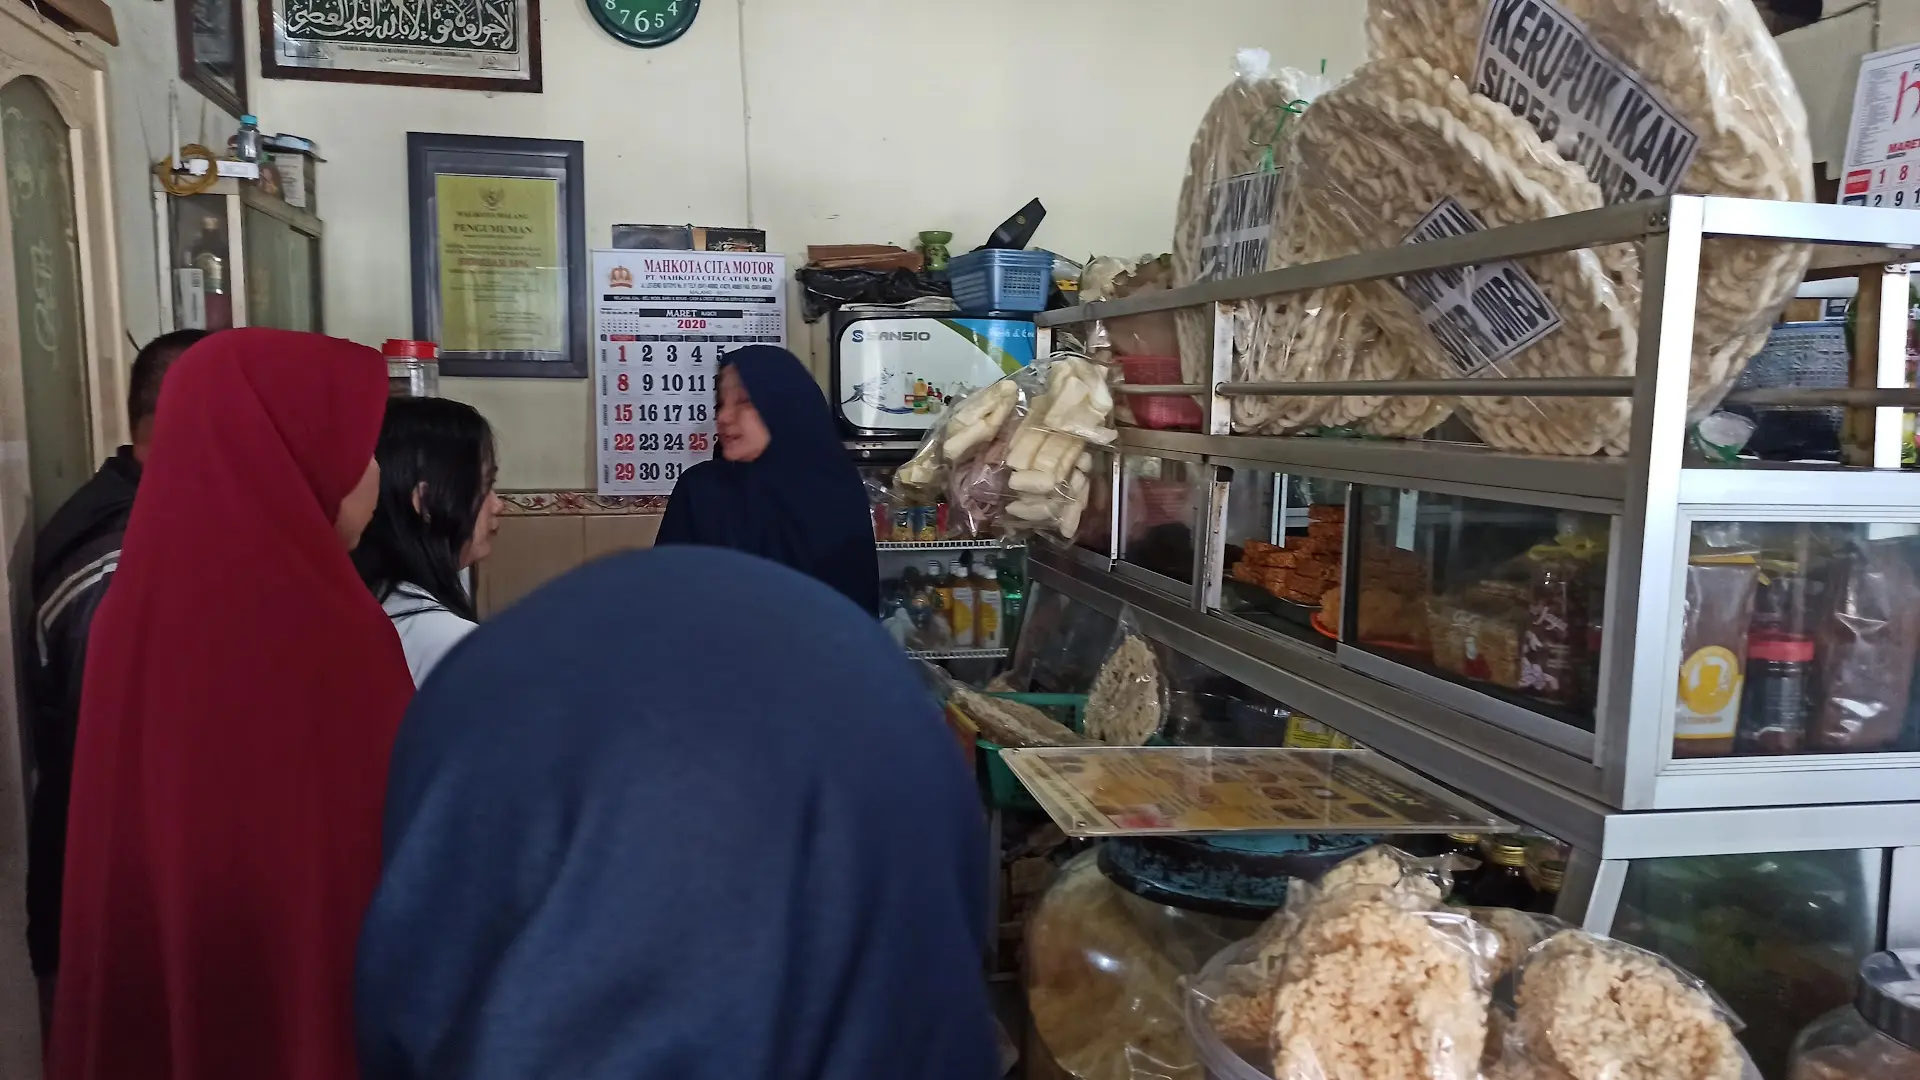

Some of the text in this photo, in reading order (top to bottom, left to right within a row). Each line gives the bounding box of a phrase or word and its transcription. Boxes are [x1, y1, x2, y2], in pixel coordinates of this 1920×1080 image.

[620, 9, 630, 24] 7
[667, 0, 678, 16] 4
[634, 9, 650, 32] 6
[654, 13, 665, 28] 5
[1489, 0, 1688, 186] KERUPUK IKAN
[1879, 168, 1886, 185] 1
[1899, 165, 1909, 181] 8
[1894, 191, 1904, 207] 9
[453, 223, 533, 234] PENGUMUMAN
[644, 259, 774, 275] MAHKOTA CITA MOTOR
[665, 309, 697, 317] MARET
[1471, 267, 1550, 347] JUMBO
[677, 319, 707, 329] 2020
[618, 345, 725, 363] 1 2 3 4 5
[617, 374, 629, 392] 8
[642, 374, 653, 391] 9
[661, 374, 684, 392] 10
[688, 374, 706, 392] 11
[614, 404, 633, 422] 15
[639, 404, 658, 422] 16
[663, 404, 683, 422] 17
[688, 404, 707, 422] 18
[614, 433, 635, 451] 22
[639, 433, 659, 451] 23
[663, 433, 684, 451] 24
[688, 433, 708, 451] 25
[615, 463, 683, 480] 29 30 31
